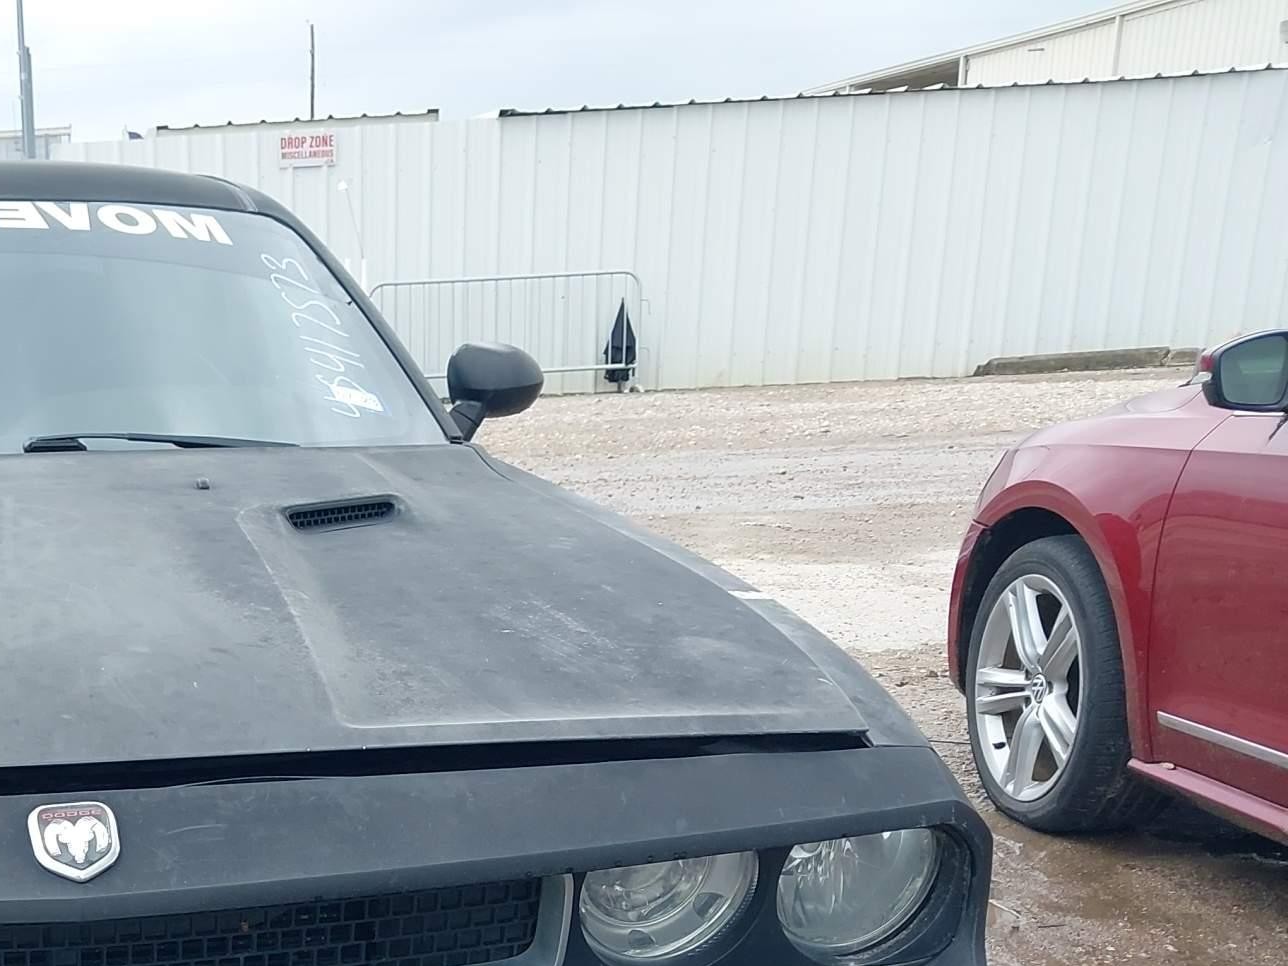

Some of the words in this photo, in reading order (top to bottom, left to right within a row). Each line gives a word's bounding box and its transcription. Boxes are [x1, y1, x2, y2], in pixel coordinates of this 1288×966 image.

[281, 136, 307, 150] DROP
[309, 134, 334, 149] ZONE
[42, 810, 101, 819] DODGE
